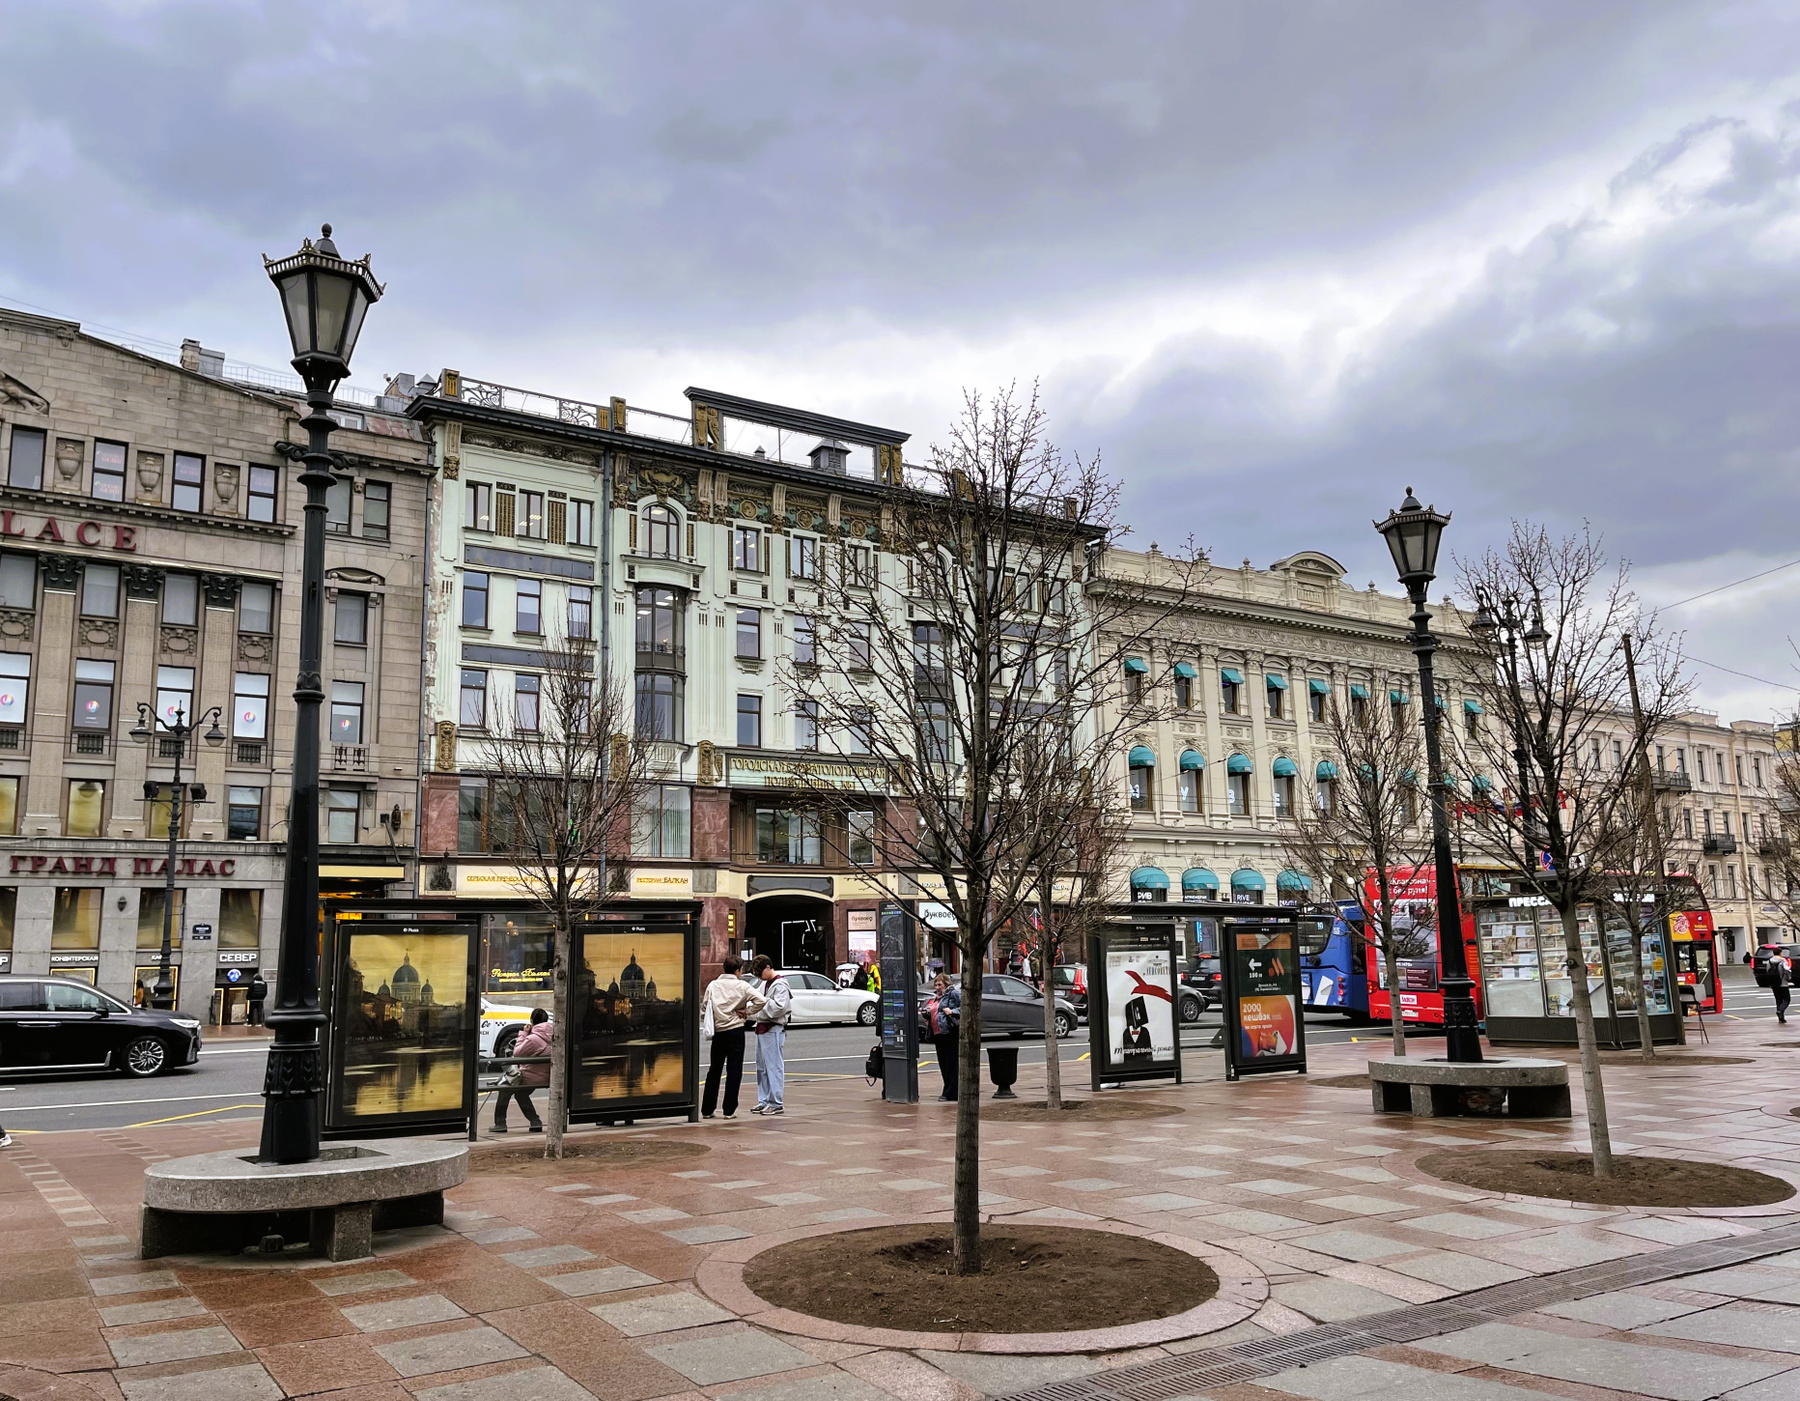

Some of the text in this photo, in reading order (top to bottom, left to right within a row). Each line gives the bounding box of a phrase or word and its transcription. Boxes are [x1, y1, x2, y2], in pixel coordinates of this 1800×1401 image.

[731, 757, 788, 773] ГОРОДСКАЯ
[9, 855, 236, 877] ГРАНД ПАЛАС
[664, 876, 689, 884] БАЛКАН
[219, 953, 257, 962] СЕВЕР
[1243, 1003, 1261, 1013] 2000
[1243, 1012, 1271, 1022] кешбэк
